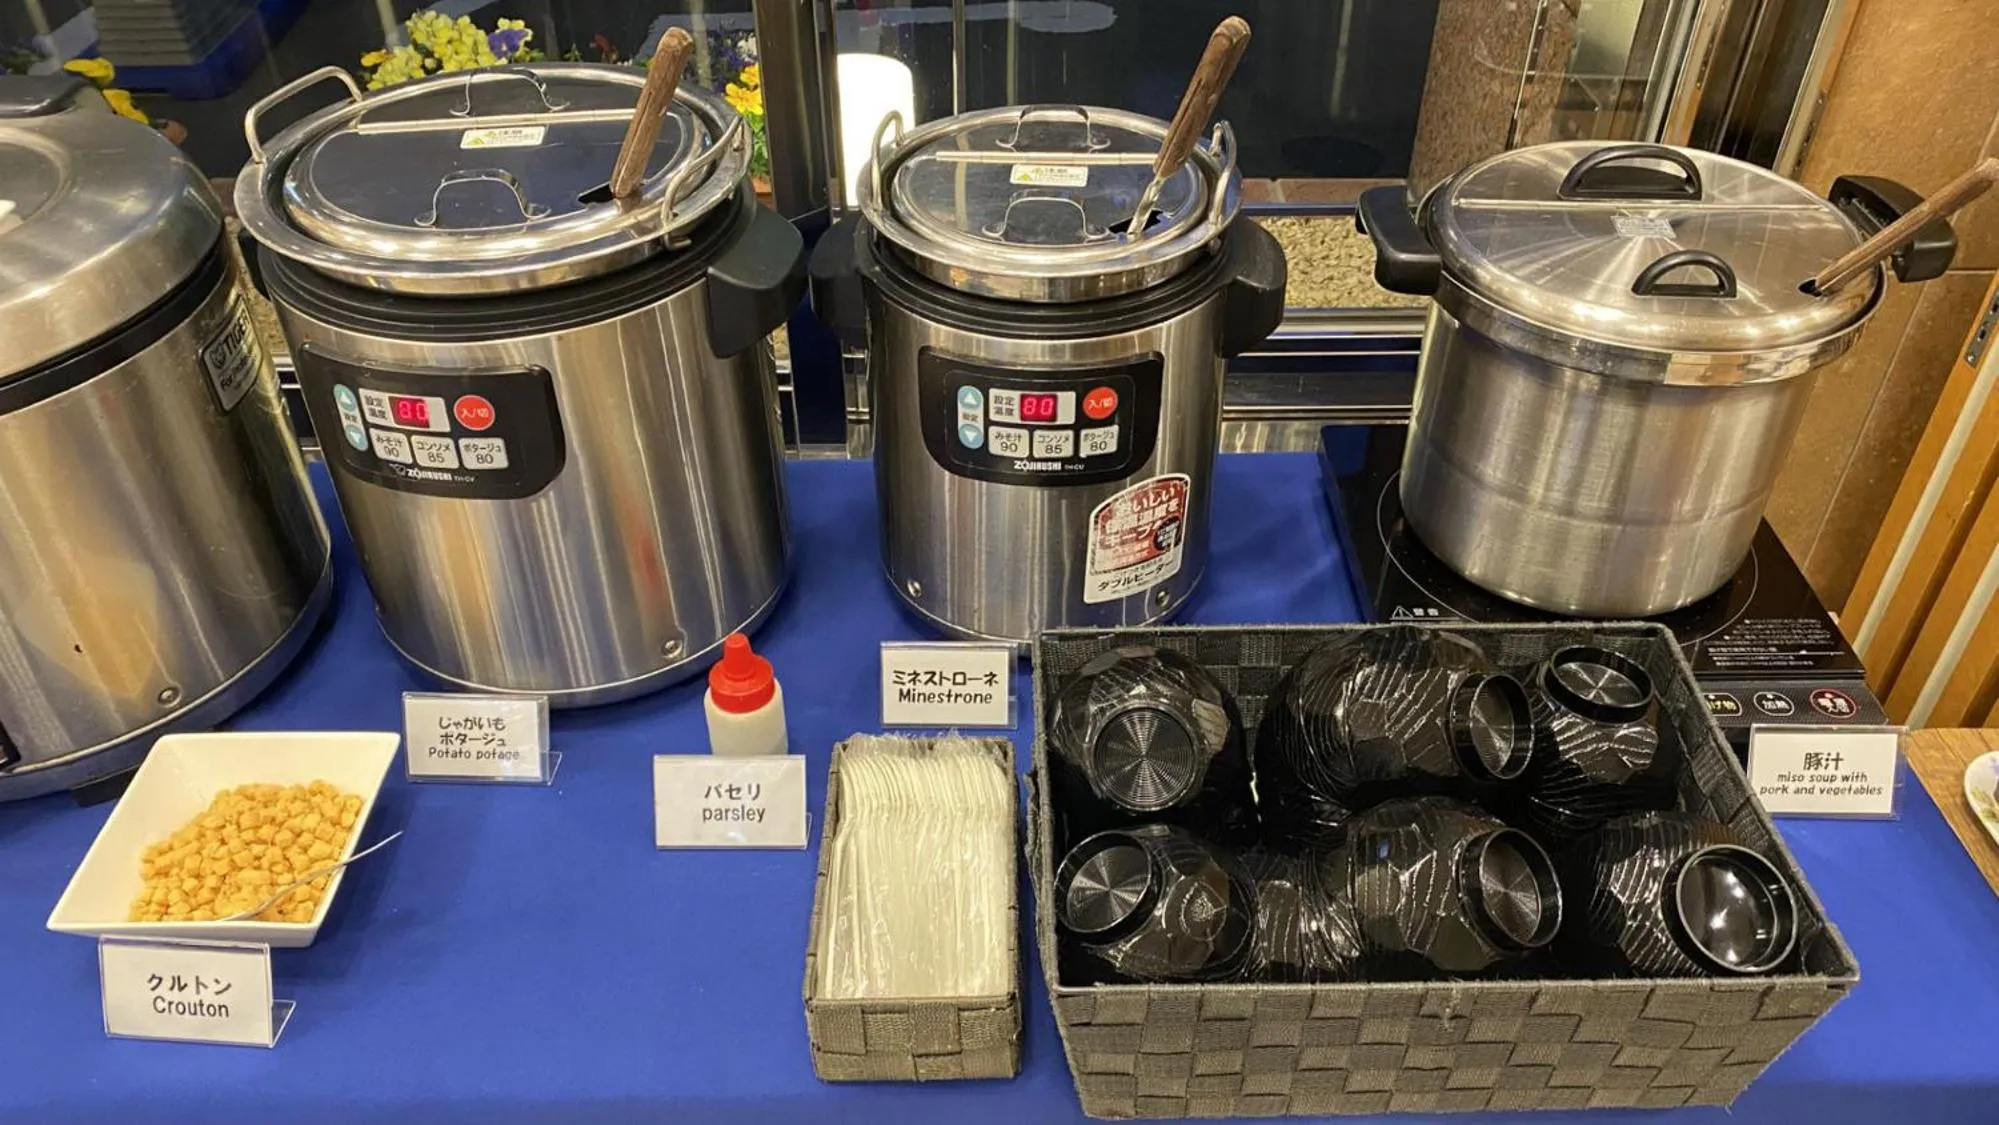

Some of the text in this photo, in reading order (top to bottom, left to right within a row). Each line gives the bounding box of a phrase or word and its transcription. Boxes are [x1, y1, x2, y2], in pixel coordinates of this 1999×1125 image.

[398, 399, 429, 421] 80
[1022, 397, 1054, 416] 80
[416, 439, 452, 451] コンソメ
[995, 433, 1022, 443] みそ汁
[1037, 434, 1070, 445] コンソメ
[1000, 442, 1018, 453] 90
[1045, 445, 1062, 455] 85
[1090, 441, 1108, 451] 80
[428, 451, 445, 463] 85
[476, 453, 494, 465] 80
[892, 670, 999, 687] ミネストローネ
[898, 687, 993, 704] Minestrone
[438, 716, 506, 731] じゃがいも
[440, 732, 507, 747] ポタージュ
[428, 747, 520, 761] Potato potage
[1802, 752, 1845, 771] 豚汁
[1777, 771, 1868, 785] miso soup with
[1760, 785, 1883, 797] pork and vegetables
[702, 805, 766, 824] parsley
[147, 972, 232, 997] クルトン
[152, 995, 229, 1018] Crouton
